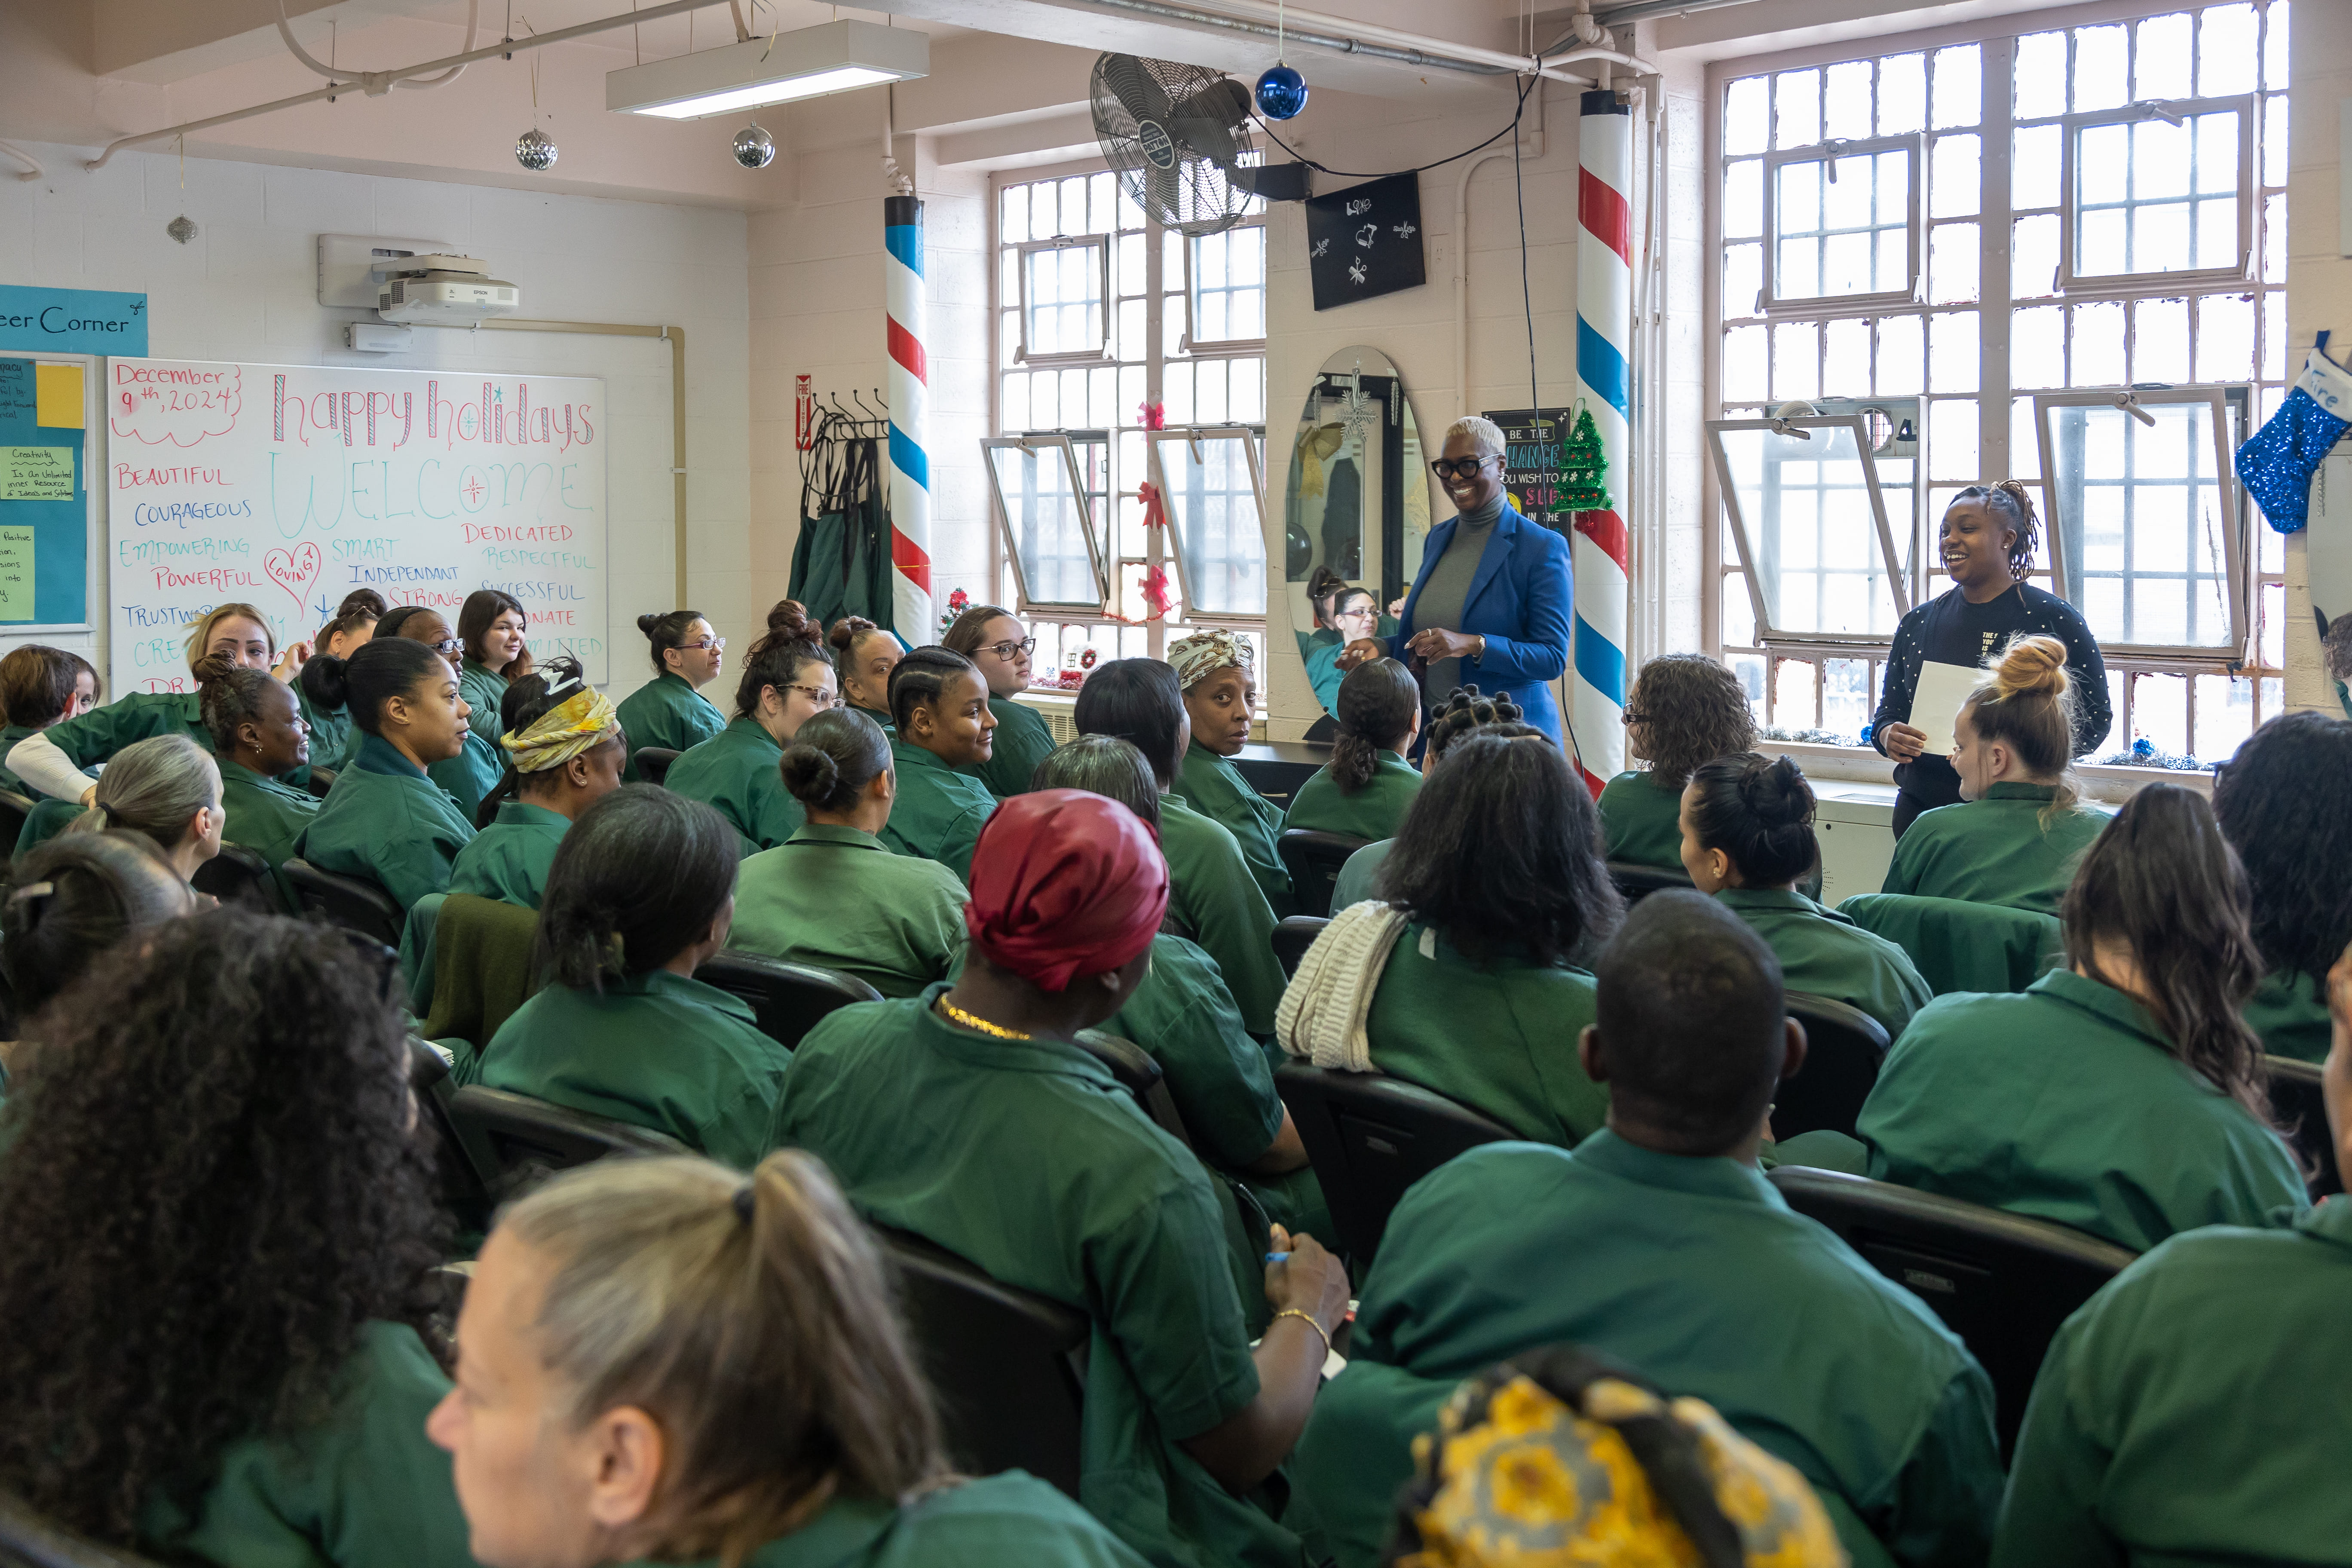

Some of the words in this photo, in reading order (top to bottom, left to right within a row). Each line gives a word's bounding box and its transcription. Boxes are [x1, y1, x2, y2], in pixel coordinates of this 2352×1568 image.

[1142, 135, 1170, 153] PATTON
[40, 306, 129, 334] Corner
[116, 364, 226, 385] December
[169, 387, 232, 413] 2024
[273, 374, 412, 452] happy
[429, 380, 594, 454] holidays
[1510, 430, 1522, 440] BE
[12, 449, 54, 464] Creativity
[1506, 444, 1560, 469] HANGE
[11, 469, 24, 478] Is
[42, 469, 72, 479] Unlimited
[114, 463, 235, 490] BEAUTIFUL
[268, 432, 594, 539] WELCOME
[1502, 474, 1516, 484] OU
[1516, 473, 1542, 484] WISH
[1544, 472, 1559, 483] TO
[135, 499, 252, 529] COURAGEOUS
[1527, 512, 1537, 522] IN
[4, 531, 31, 542] Positive
[461, 523, 573, 544] DEDICATED
[119, 537, 250, 567] EMPOWERING
[332, 537, 401, 562] SMART
[481, 546, 597, 570] RESPECTFUL
[6, 574, 21, 582] into
[150, 566, 263, 592] POWERFUL
[269, 556, 313, 582] LOVING
[349, 564, 459, 584] INDEPENDANT
[389, 587, 463, 610] STRONG
[121, 604, 220, 627] TRUSTWR
